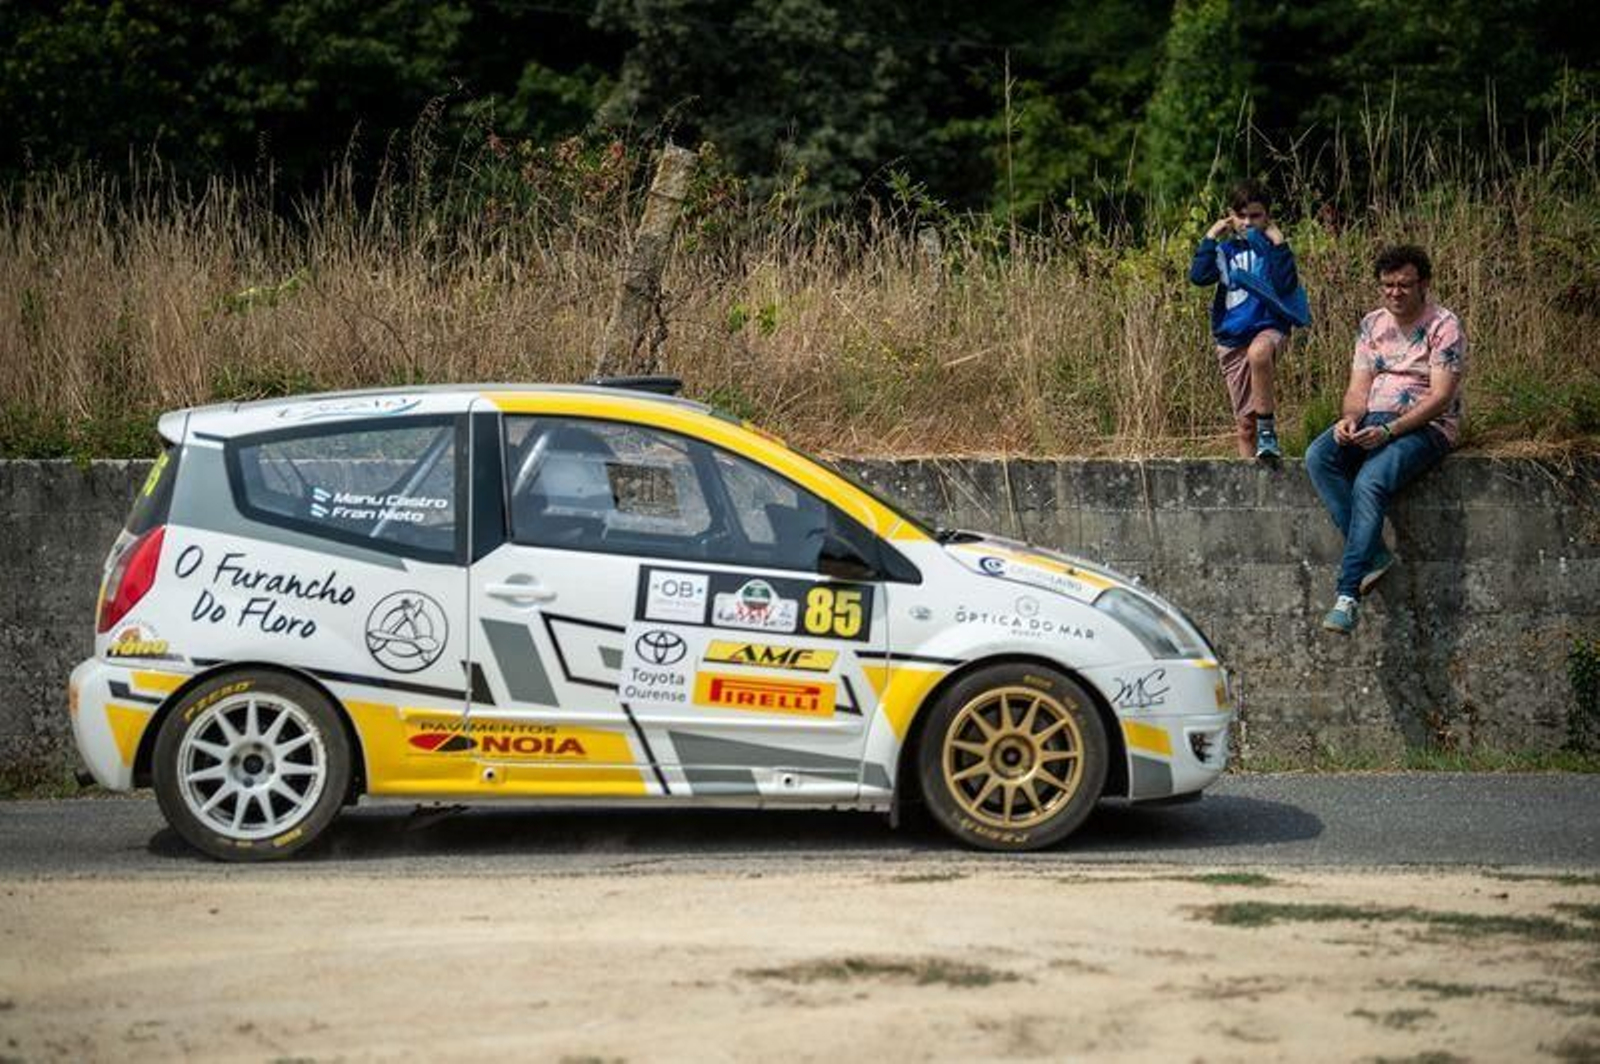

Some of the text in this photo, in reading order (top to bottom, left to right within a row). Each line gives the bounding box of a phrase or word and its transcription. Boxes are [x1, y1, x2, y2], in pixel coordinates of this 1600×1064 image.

[333, 492, 448, 509] Manu Castro
[331, 506, 377, 520] Fran
[175, 545, 356, 605] O Furancho
[661, 579, 694, 598] OB
[191, 589, 317, 638] Do Floro
[804, 586, 862, 637] 85
[954, 605, 1095, 640] ÓPTICA DO MAR
[729, 644, 814, 666] AMF
[631, 667, 686, 687] Toyota
[625, 685, 687, 702] Ourense
[709, 678, 821, 711] PIRELLI
[420, 722, 558, 735] PAVIMENTOS
[481, 735, 587, 756] NOIA
